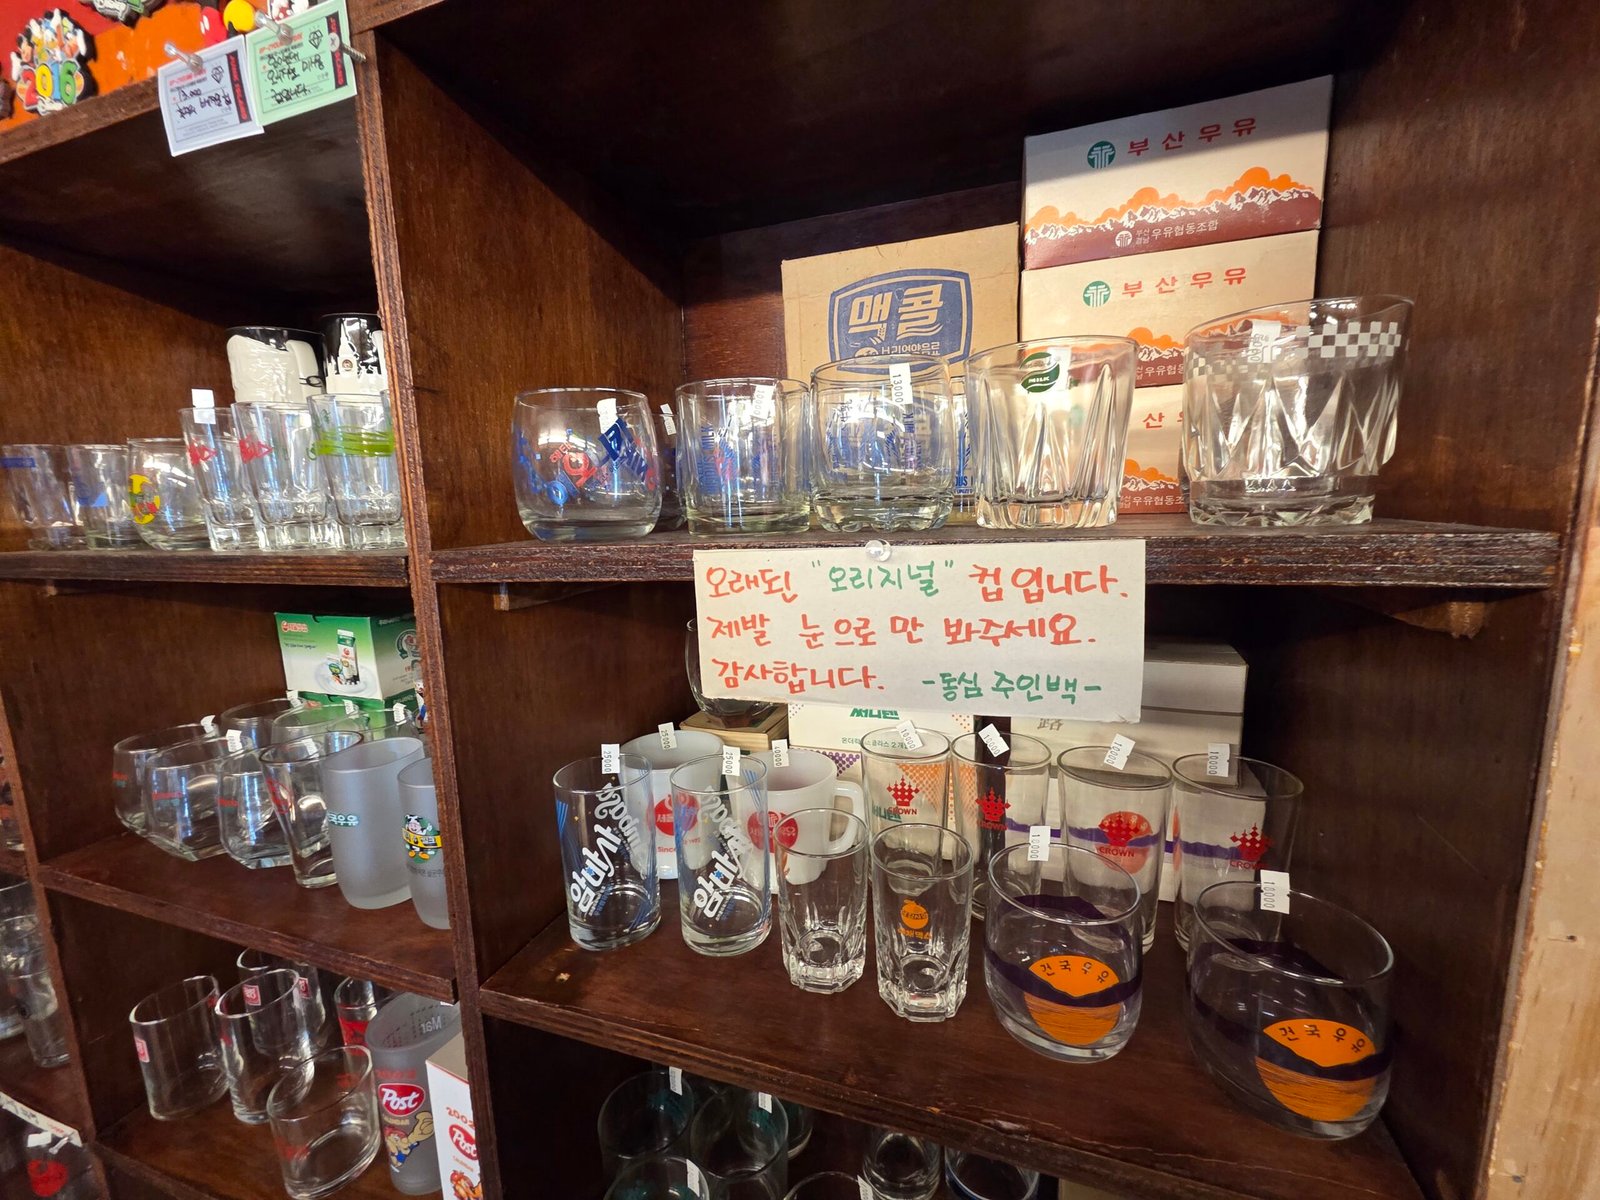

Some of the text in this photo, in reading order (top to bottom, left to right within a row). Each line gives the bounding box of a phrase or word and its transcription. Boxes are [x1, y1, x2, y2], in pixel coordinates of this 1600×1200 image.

[22, 61, 78, 108] 2016
[1127, 117, 1257, 157] 부산우유
[1151, 219, 1219, 240] 우유협동조합
[1121, 266, 1248, 298] 부산우유
[848, 283, 944, 345] 맥콜
[892, 374, 904, 403] 13000
[706, 566, 798, 603] 오래된
[707, 613, 772, 647] 제발
[944, 613, 1096, 647] 봐주세요.
[711, 658, 885, 694] 감사합니다.
[661, 729, 671, 750] 25000
[901, 728, 916, 749] 10000
[983, 734, 1000, 755] 10000
[603, 750, 612, 773] 25000
[725, 751, 734, 774] 25000
[1106, 741, 1123, 765] 10000
[1207, 751, 1219, 775] 10000
[888, 806, 917, 815] CROWN
[977, 820, 1008, 831] CROWN
[1098, 848, 1135, 858] CROWN
[1040, 960, 1109, 983] 건국우유
[1278, 1024, 1365, 1053] 건국우유
[381, 1087, 420, 1110] Post
